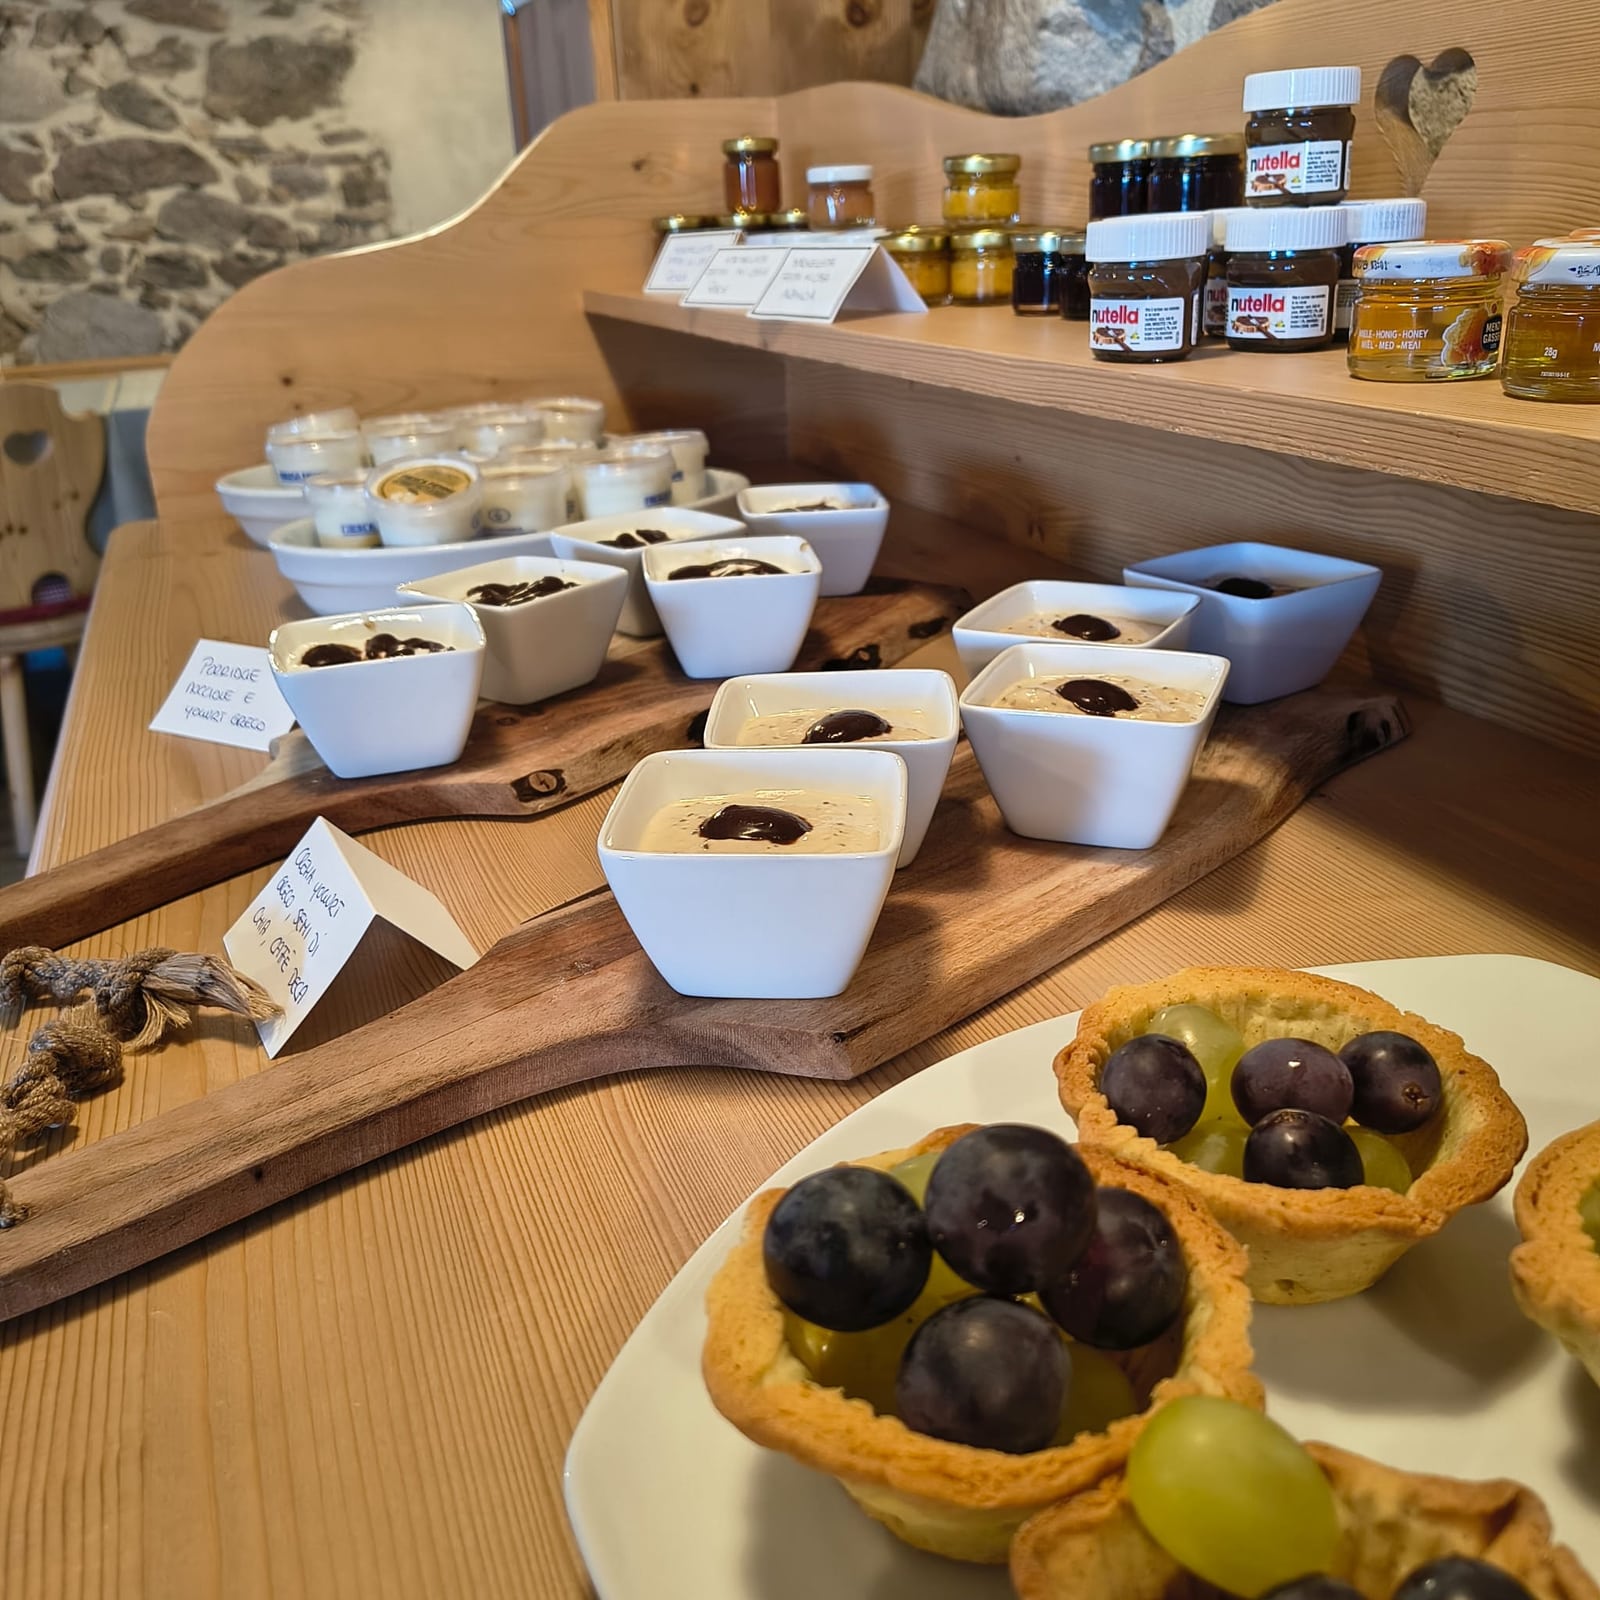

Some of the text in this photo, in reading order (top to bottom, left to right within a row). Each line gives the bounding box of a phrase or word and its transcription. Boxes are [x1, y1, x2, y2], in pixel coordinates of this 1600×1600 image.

[1250, 151, 1300, 172] nutella
[1231, 293, 1285, 313] nutella
[1092, 305, 1139, 324] nutella
[1375, 329, 1398, 338] HONIG
[1402, 329, 1429, 338] HONEY
[1379, 341, 1395, 349] MED
[1544, 347, 1558, 359] 28g
[244, 692, 256, 704] E
[230, 713, 266, 731] GRECO
